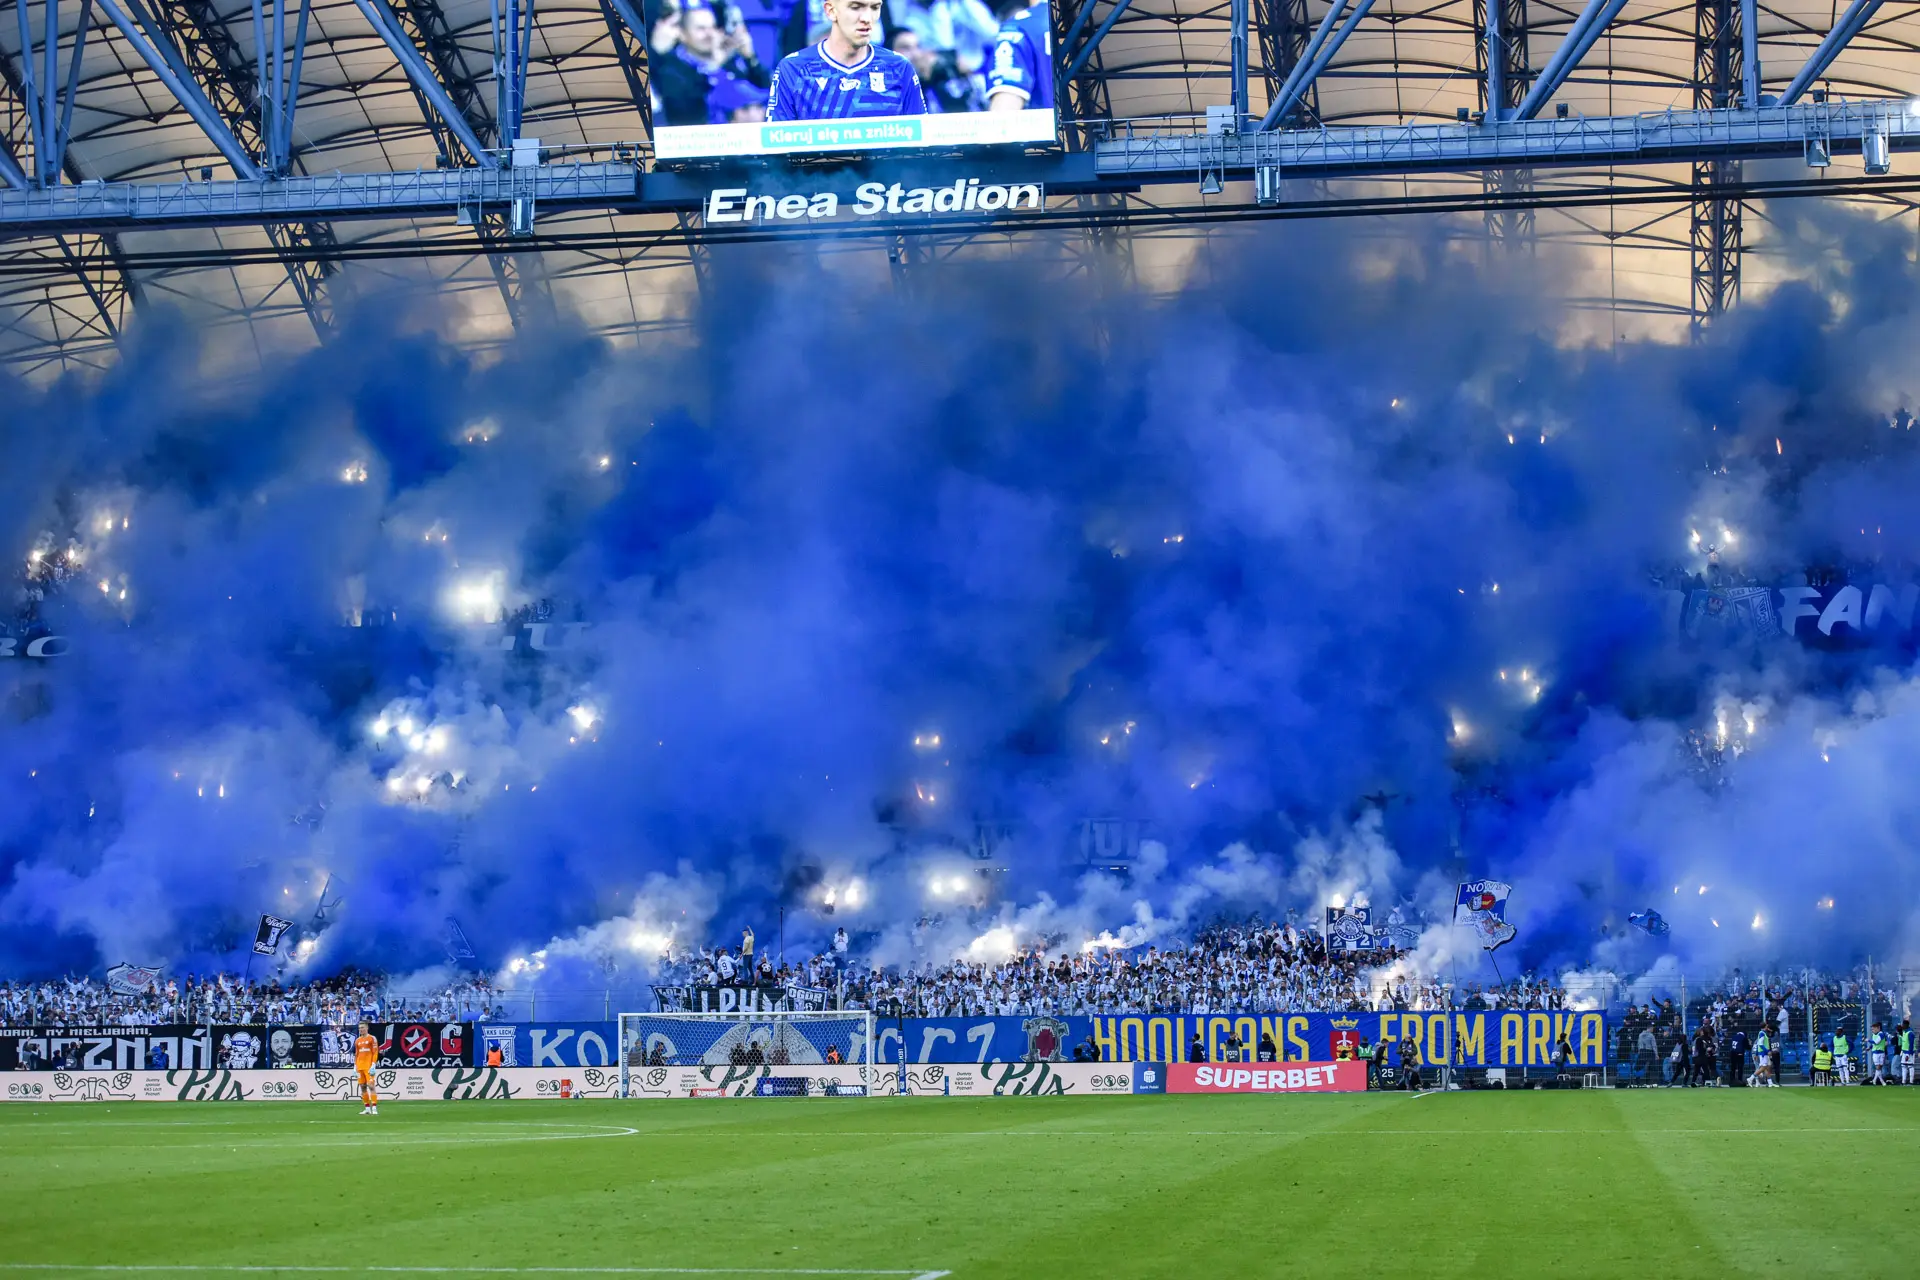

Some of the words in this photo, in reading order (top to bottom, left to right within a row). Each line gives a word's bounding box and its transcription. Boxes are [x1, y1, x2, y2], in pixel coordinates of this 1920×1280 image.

[769, 127, 813, 144] Kieruj
[817, 127, 839, 142] się
[843, 126, 862, 140] na
[866, 122, 914, 140] zniżkę
[707, 187, 839, 223] Enea
[851, 178, 1040, 216] Stadion
[1332, 935, 1343, 947] 2
[1360, 934, 1370, 946] 2
[1094, 1016, 1310, 1062] HOOLIGANS
[1379, 1013, 1486, 1065] FROM
[1500, 1012, 1603, 1065] ARKA
[1360, 1046, 1371, 1054] TV
[377, 1057, 463, 1067] RACOVIA
[1382, 1068, 1394, 1078] 25
[166, 1070, 254, 1100] Pils
[431, 1067, 521, 1099] Pils
[980, 1063, 1075, 1096] Pils
[1194, 1064, 1338, 1089] SUPERBET
